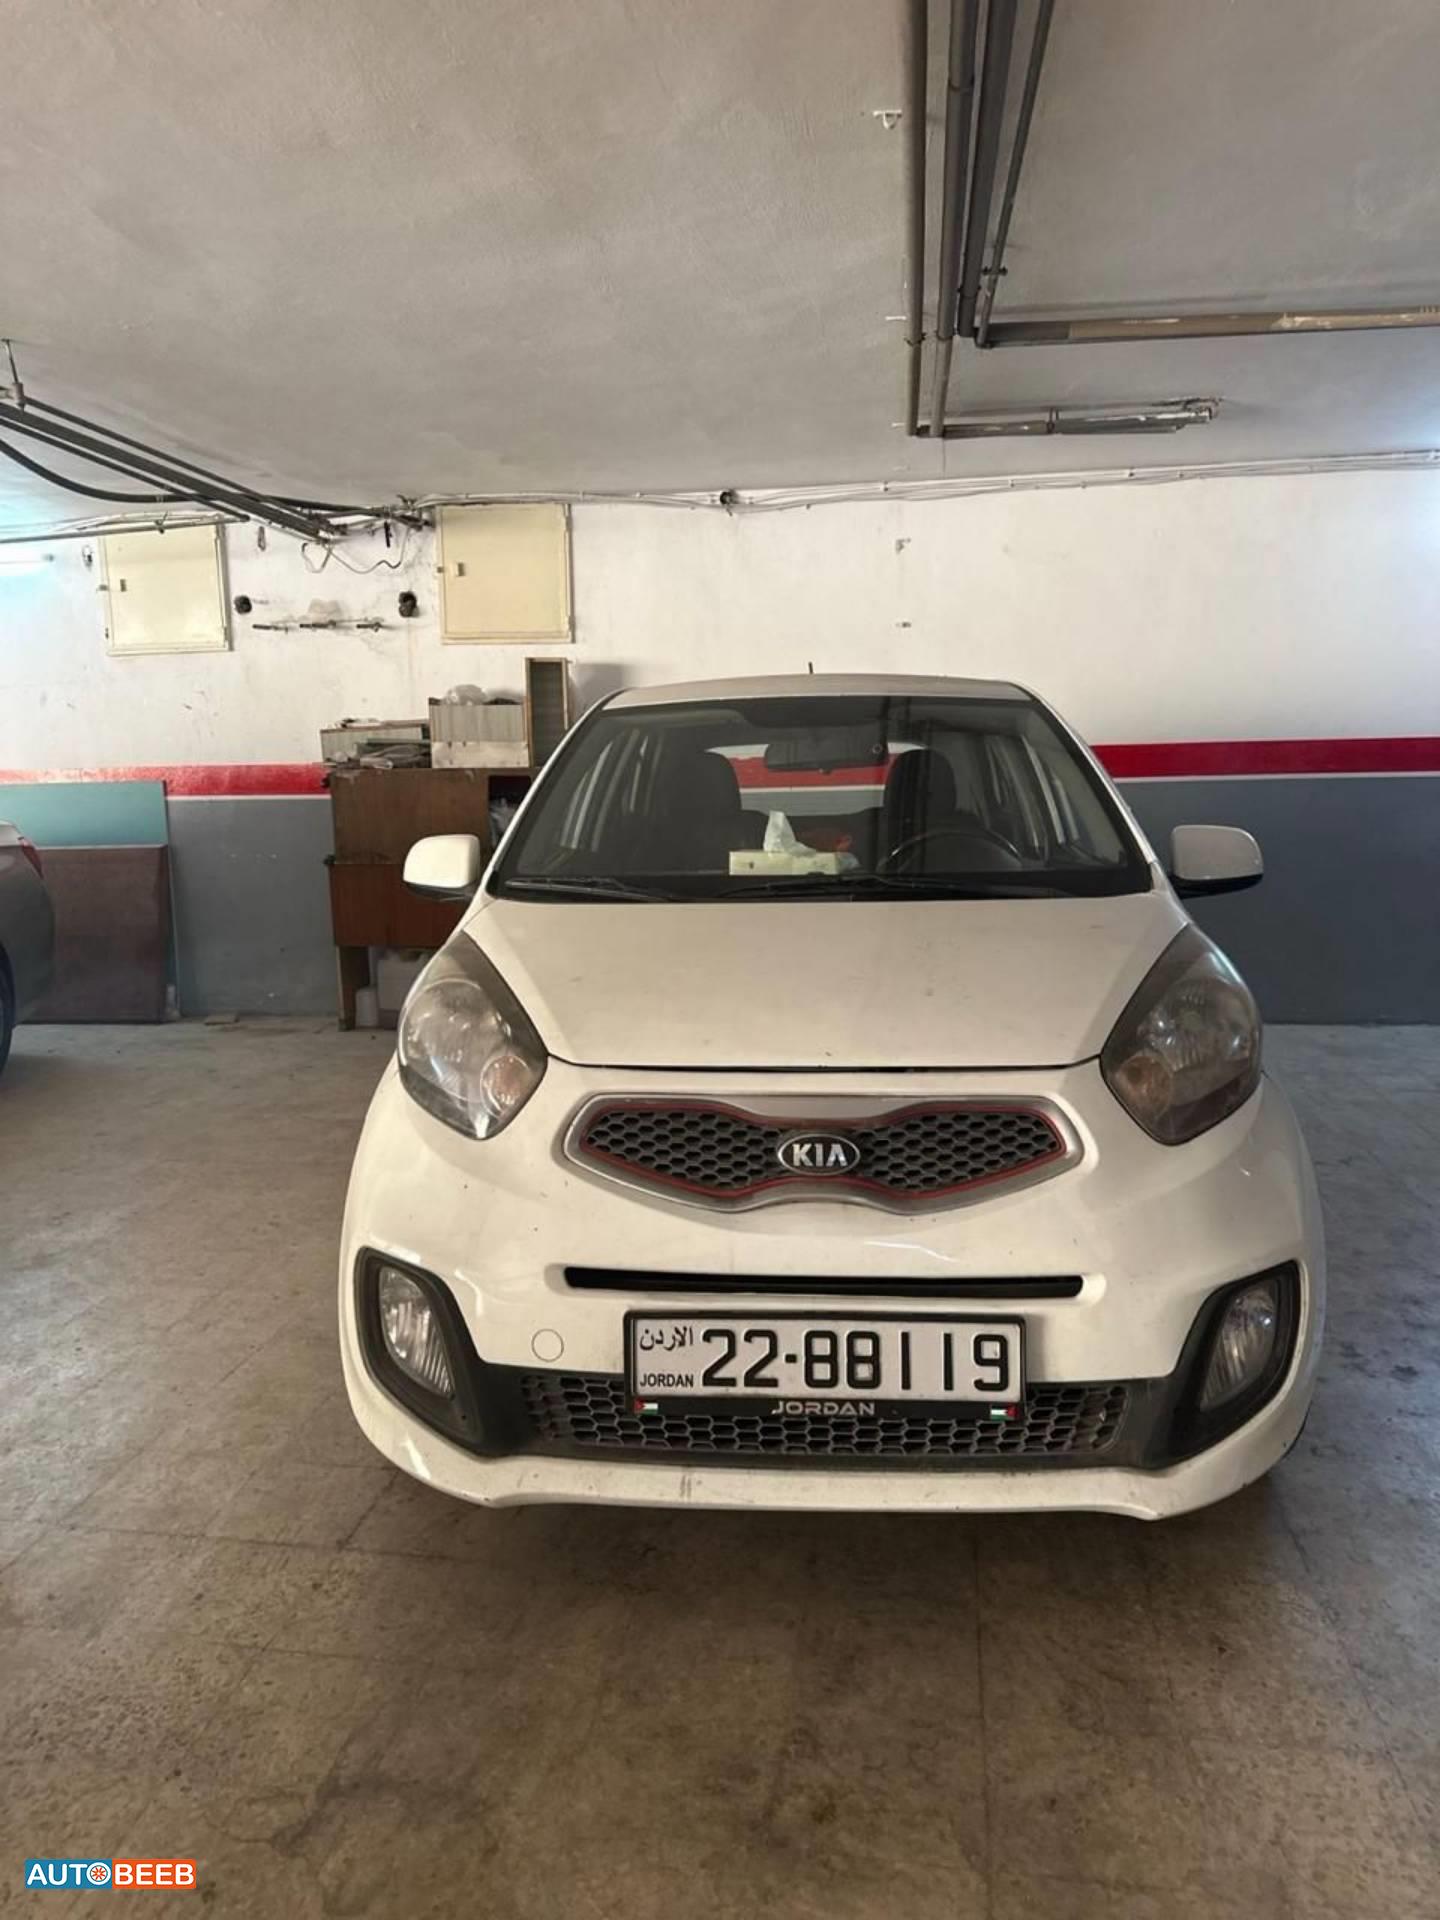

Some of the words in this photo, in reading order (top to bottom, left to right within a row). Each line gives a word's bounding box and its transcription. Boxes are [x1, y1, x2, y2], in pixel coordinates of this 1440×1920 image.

[792, 1143, 848, 1167] KIA
[701, 1329, 1010, 1391] 22-88119
[639, 1373, 694, 1388] JORDAN
[771, 1401, 876, 1416] JORDAN
